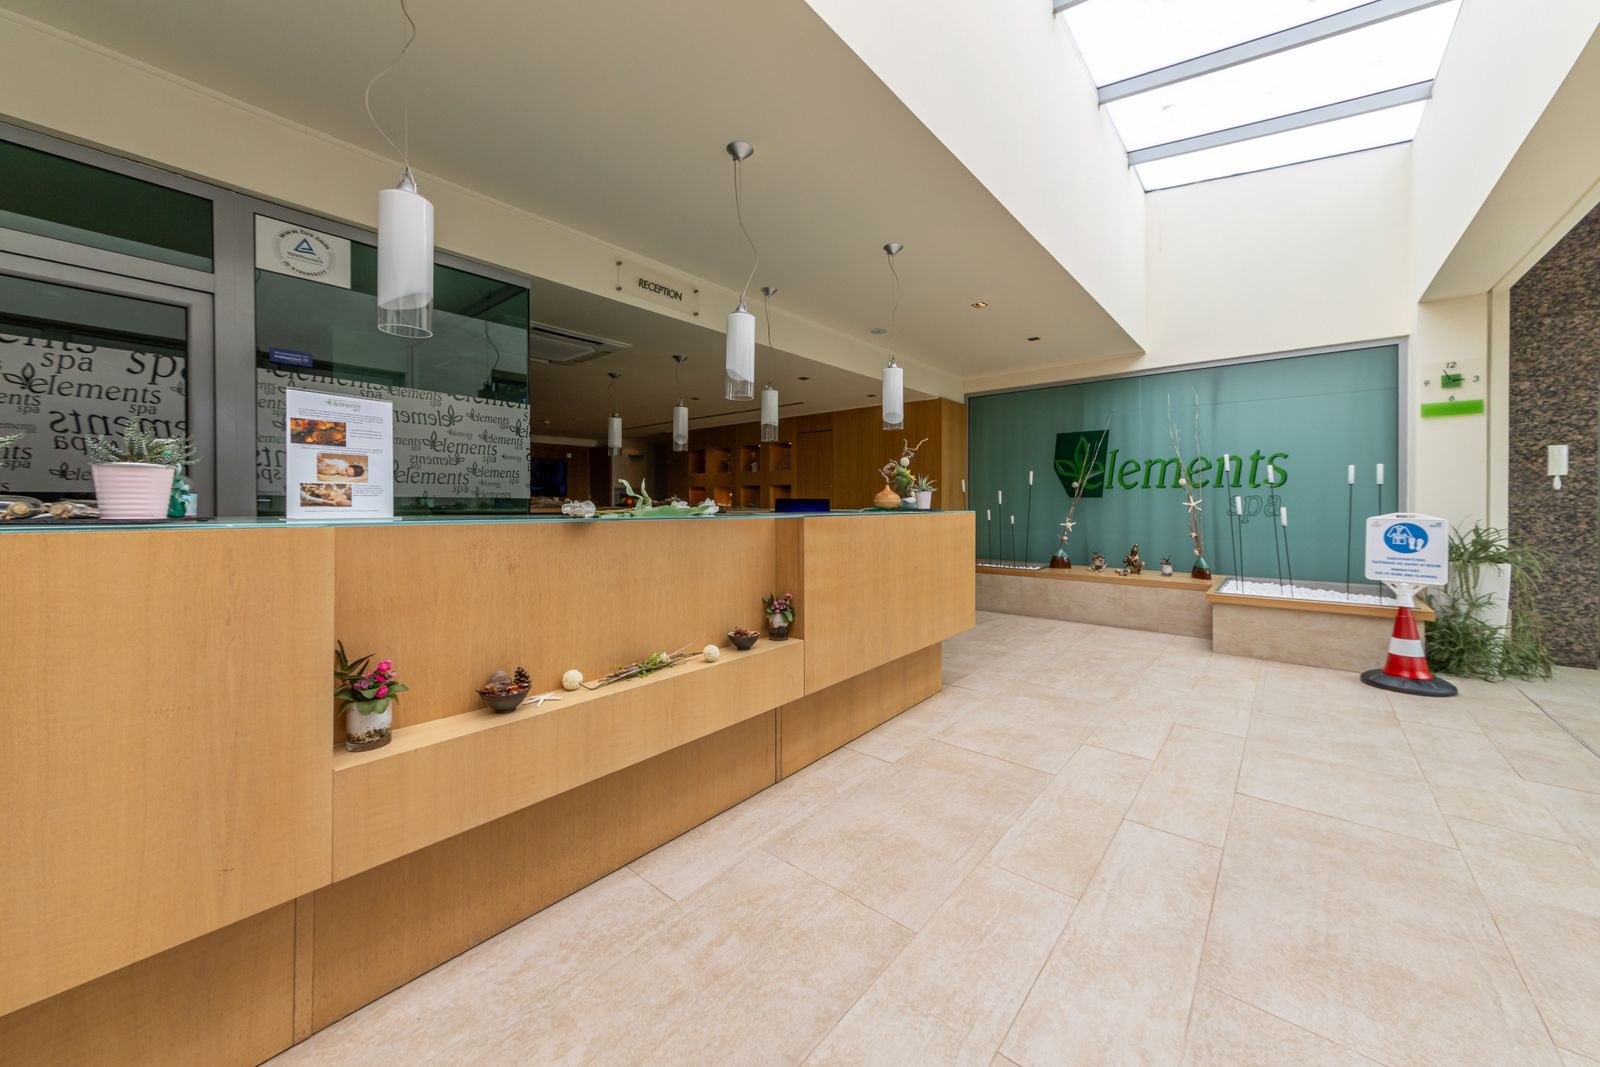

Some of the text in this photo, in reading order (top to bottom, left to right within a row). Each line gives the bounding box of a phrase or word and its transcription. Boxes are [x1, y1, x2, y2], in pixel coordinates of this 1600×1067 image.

[638, 278, 683, 302] RECEPTION
[40, 352, 93, 374] spa
[126, 352, 186, 385] sp
[1446, 361, 1457, 369] 12
[1472, 375, 1480, 383] 3
[29, 374, 162, 405] elements
[16, 406, 40, 415] spa
[128, 403, 157, 416] spa
[434, 437, 498, 457] elements
[395, 467, 470, 486] elements
[474, 466, 521, 479] elements
[1081, 448, 1289, 491] elements
[452, 485, 469, 495] spa
[1227, 494, 1281, 522] spa
